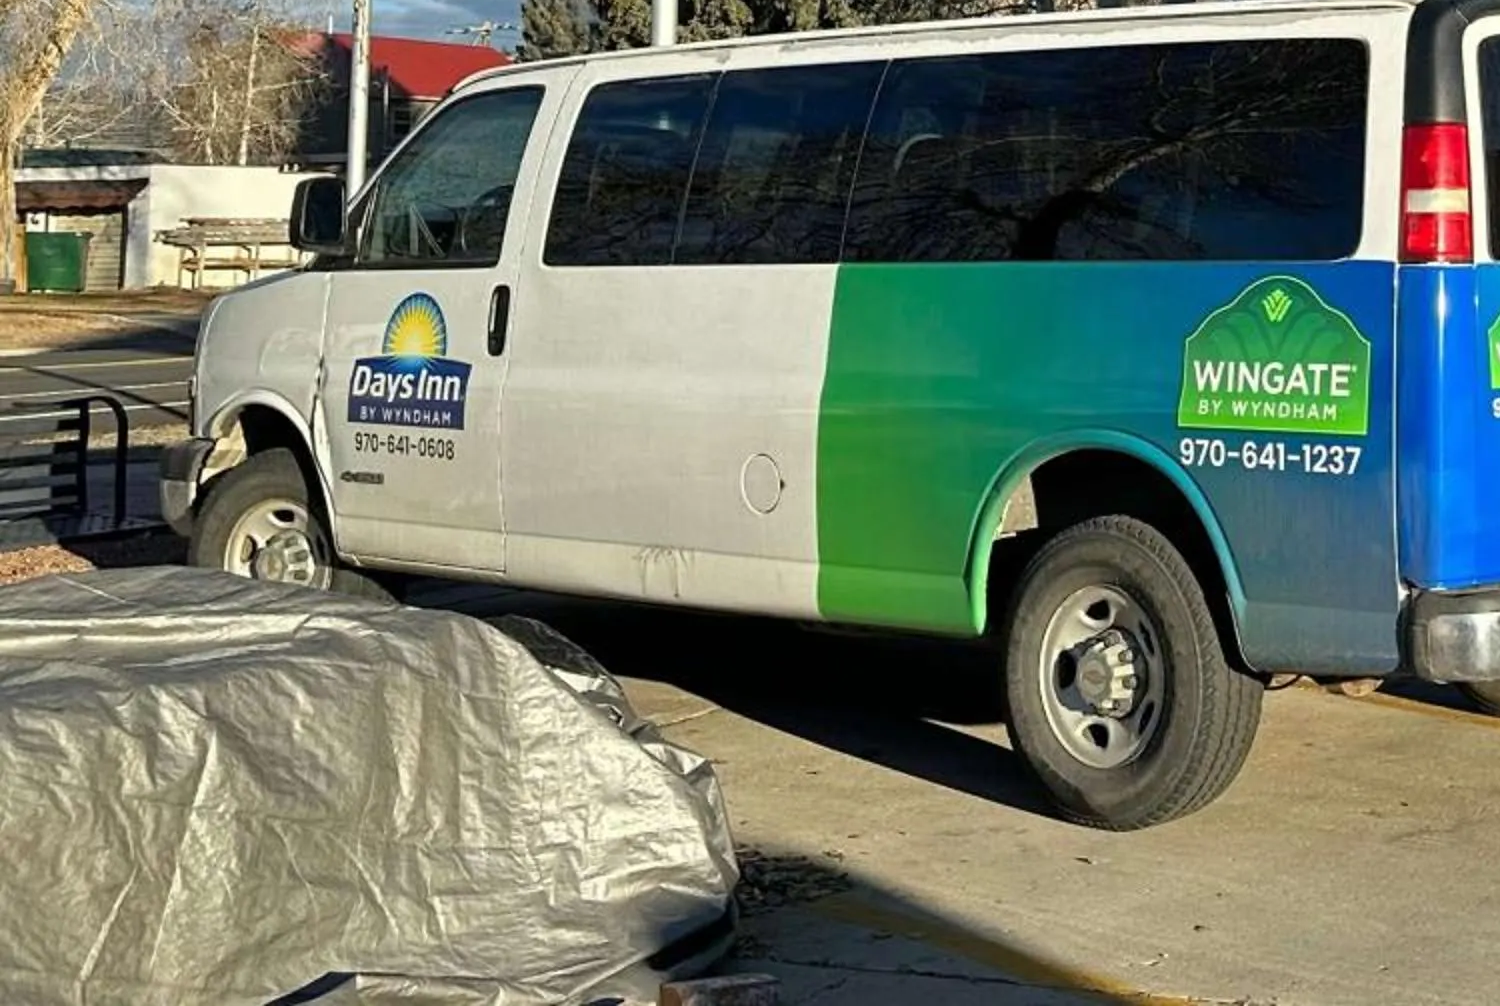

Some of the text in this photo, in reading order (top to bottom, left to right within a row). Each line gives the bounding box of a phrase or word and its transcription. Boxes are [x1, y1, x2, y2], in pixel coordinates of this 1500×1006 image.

[352, 365, 462, 403] Days Inn
[1193, 359, 1352, 397] WINGATE
[359, 405, 451, 425] BY WYNDHAM
[1198, 399, 1338, 421] BY WYNDHAM
[354, 432, 456, 461] 970-641-0608
[1180, 438, 1362, 475] 970-641-1237
